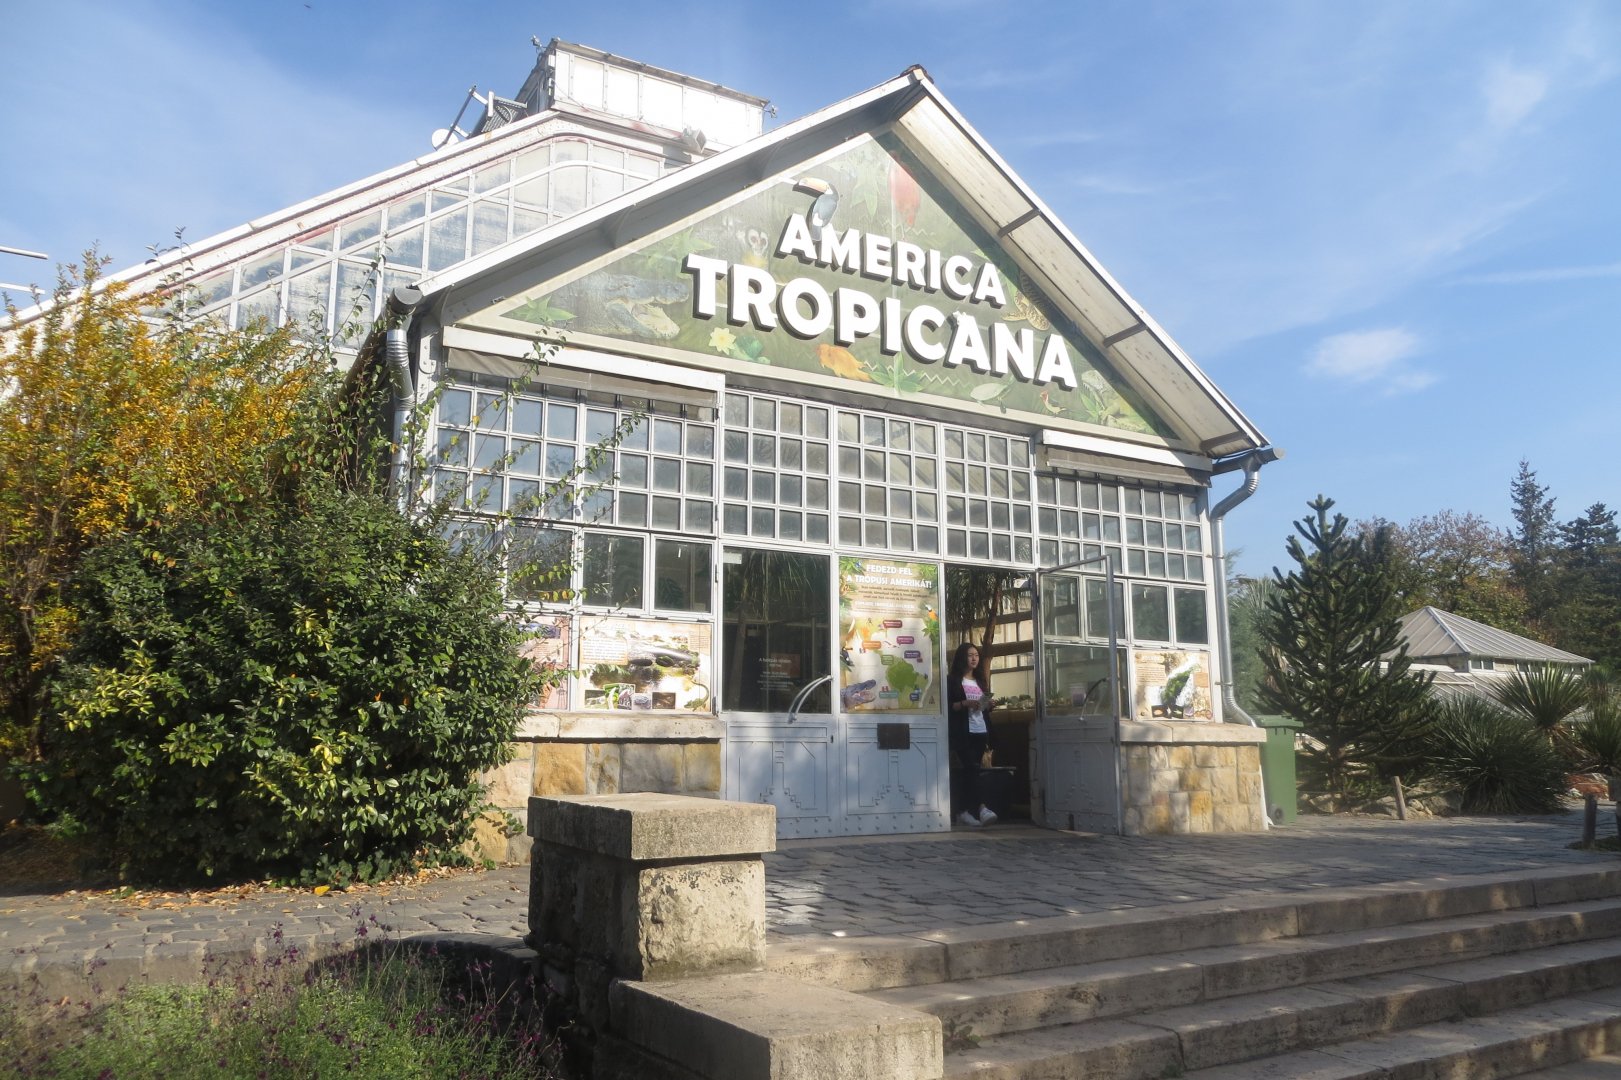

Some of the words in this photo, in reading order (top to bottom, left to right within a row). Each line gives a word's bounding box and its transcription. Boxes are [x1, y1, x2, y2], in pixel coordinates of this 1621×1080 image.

[775, 213, 1007, 307] AMERICA
[683, 252, 1077, 390] TROPICANA
[847, 574, 853, 582] A
[889, 578, 932, 589] AMERIKÁT!
[867, 564, 896, 574] FEDEZD
[899, 567, 912, 576] FEL
